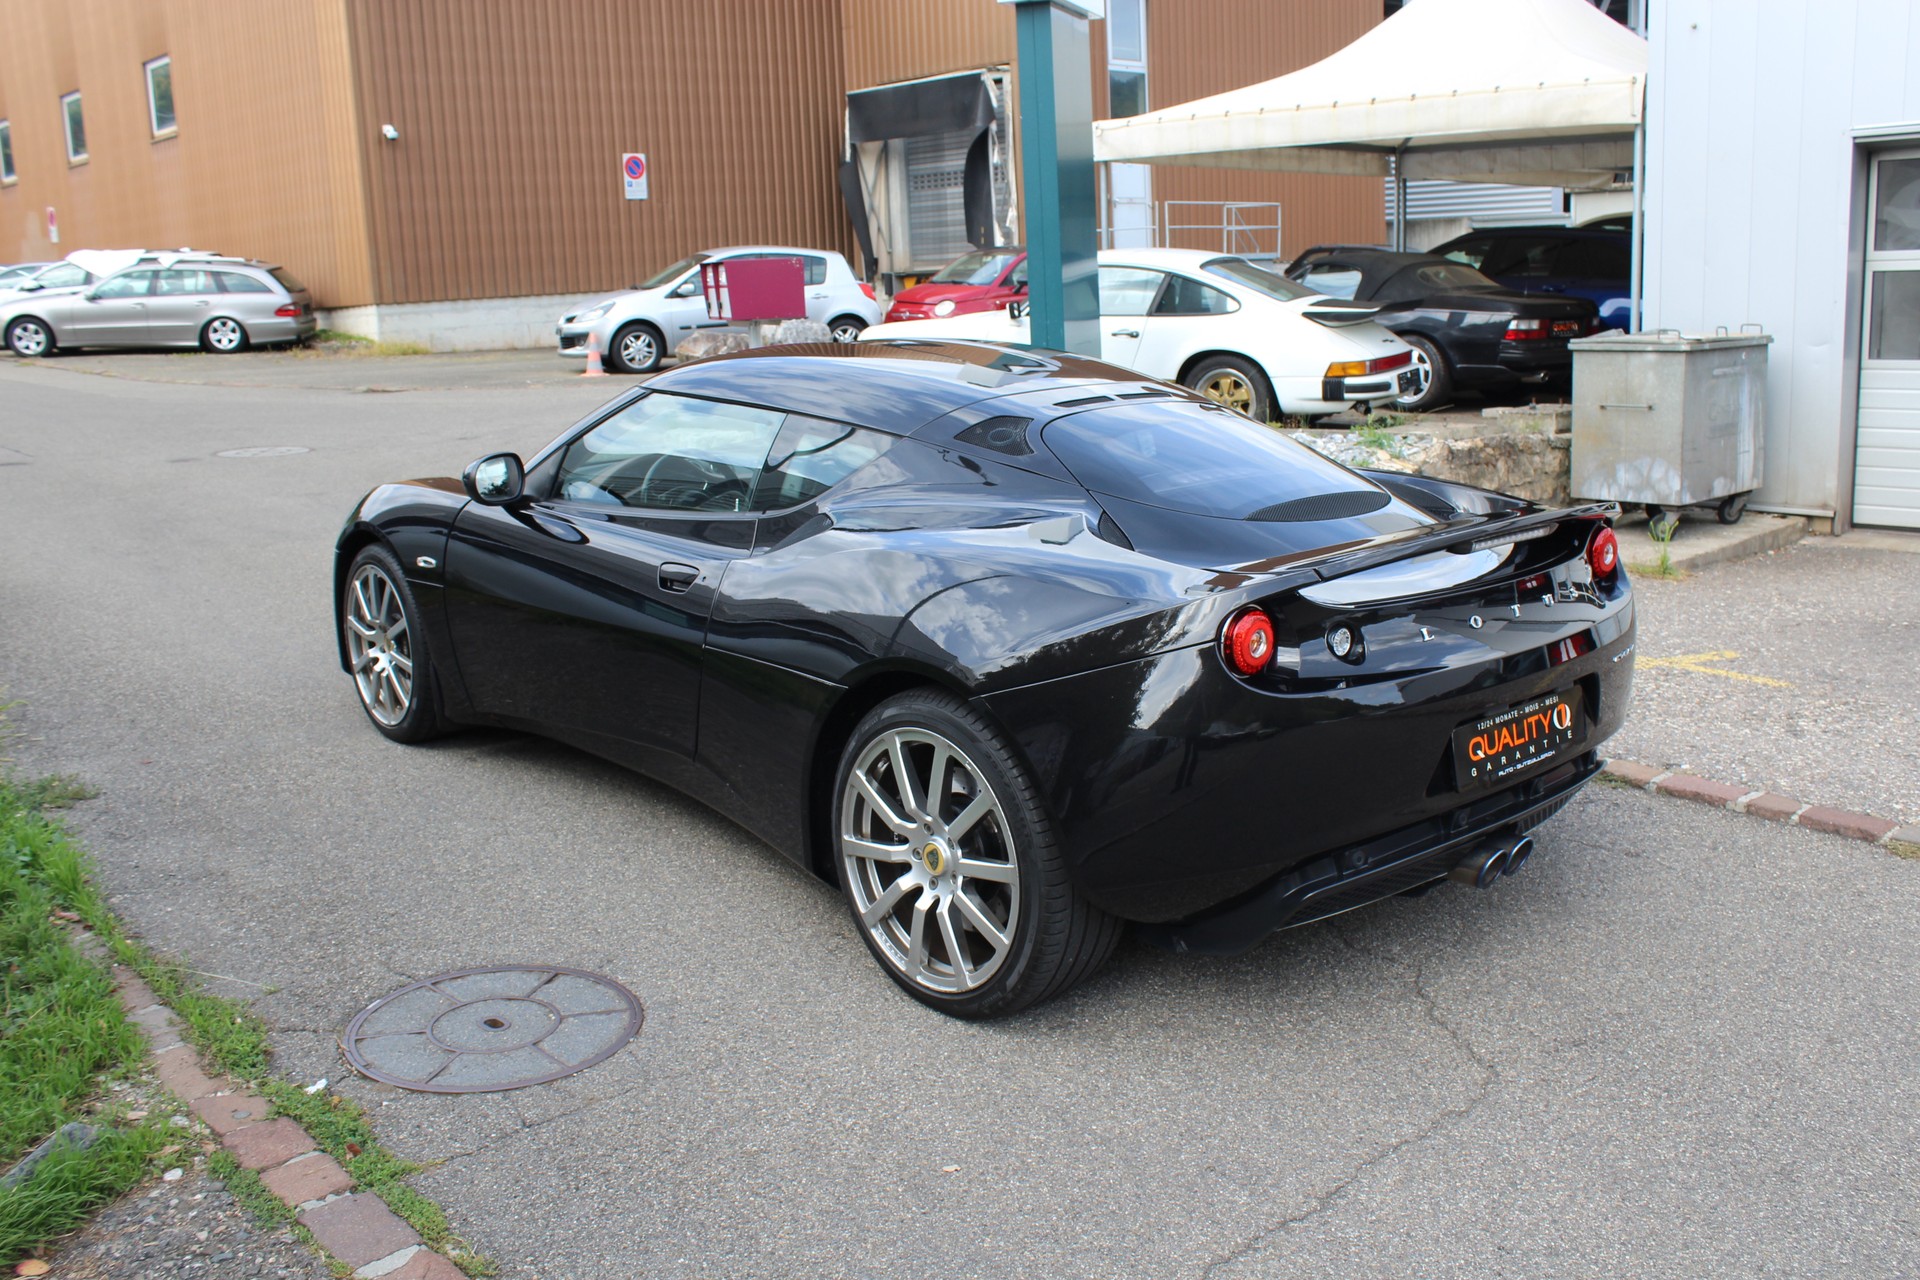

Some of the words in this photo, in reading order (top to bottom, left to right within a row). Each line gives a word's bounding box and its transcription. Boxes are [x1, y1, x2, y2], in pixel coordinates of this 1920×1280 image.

[1419, 586, 1579, 643] LOTUS
[1468, 709, 1553, 762] QUALITY
[1477, 719, 1494, 731] 12/24
[1495, 709, 1519, 724] MONATE
[1525, 702, 1539, 713] MOIS
[1545, 695, 1559, 706] MESI
[1471, 730, 1573, 777] GARANTIE
